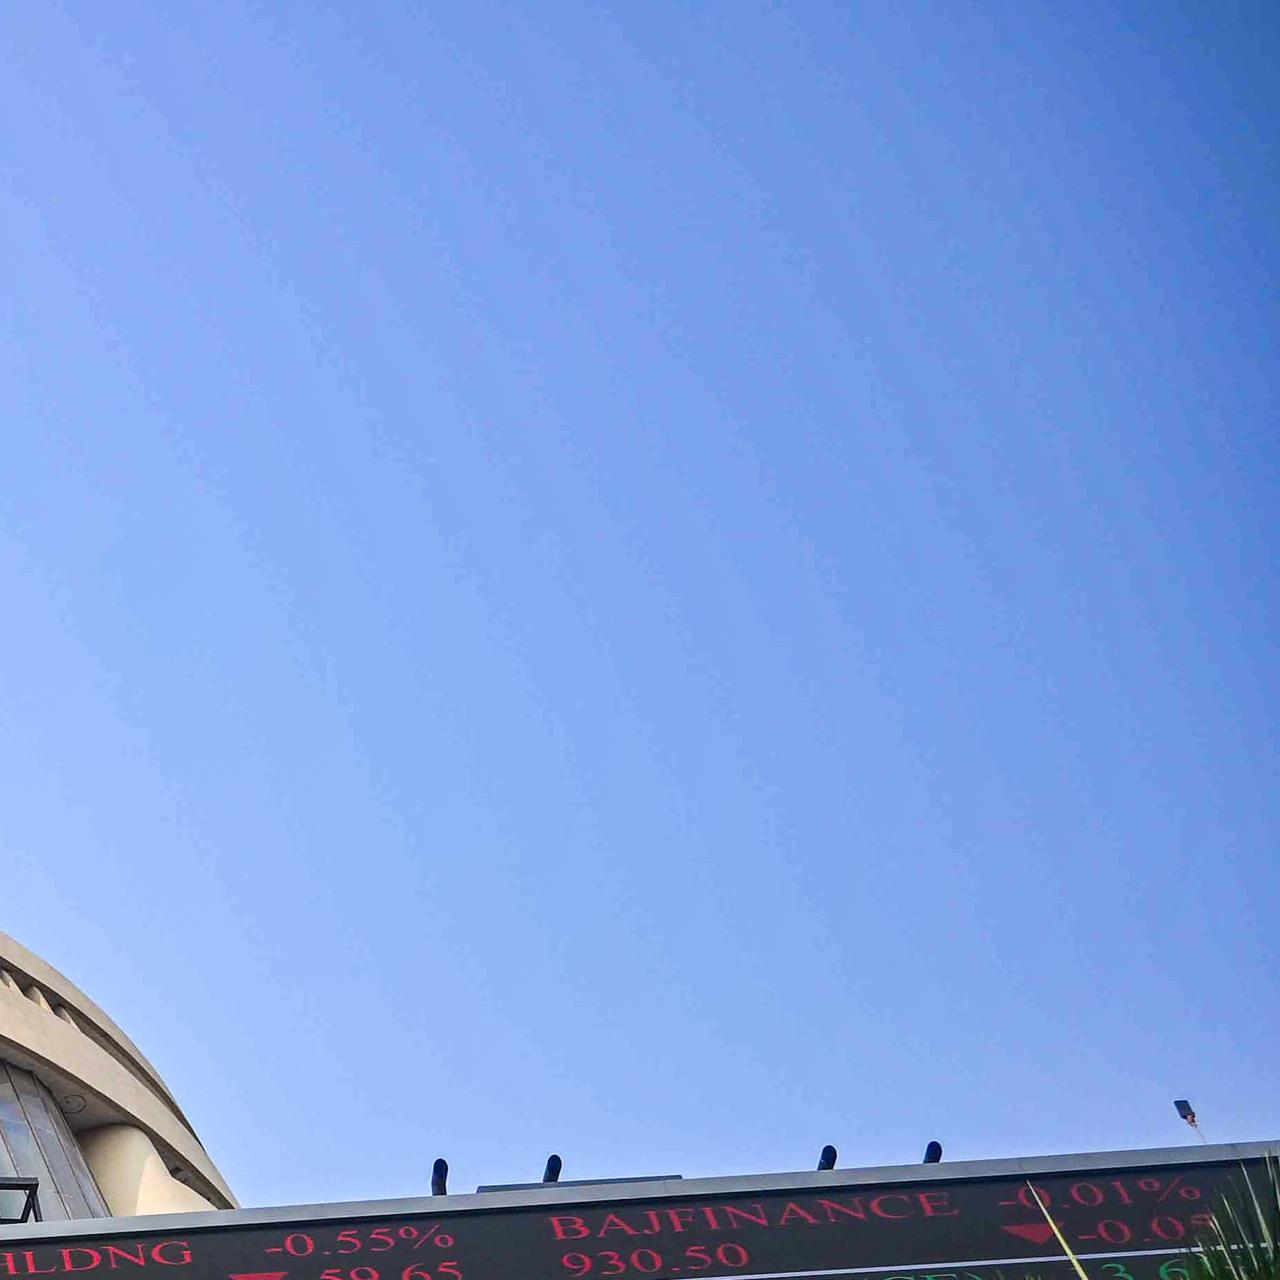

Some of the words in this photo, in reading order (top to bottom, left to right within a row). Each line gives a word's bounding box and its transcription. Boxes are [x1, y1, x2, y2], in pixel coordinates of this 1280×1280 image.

[551, 1191, 960, 1241] BAJFINANCE
[998, 1176, 1201, 1210] -0.01%
[265, 1224, 455, 1257] -0.55%
[561, 1242, 750, 1277] 930.50
